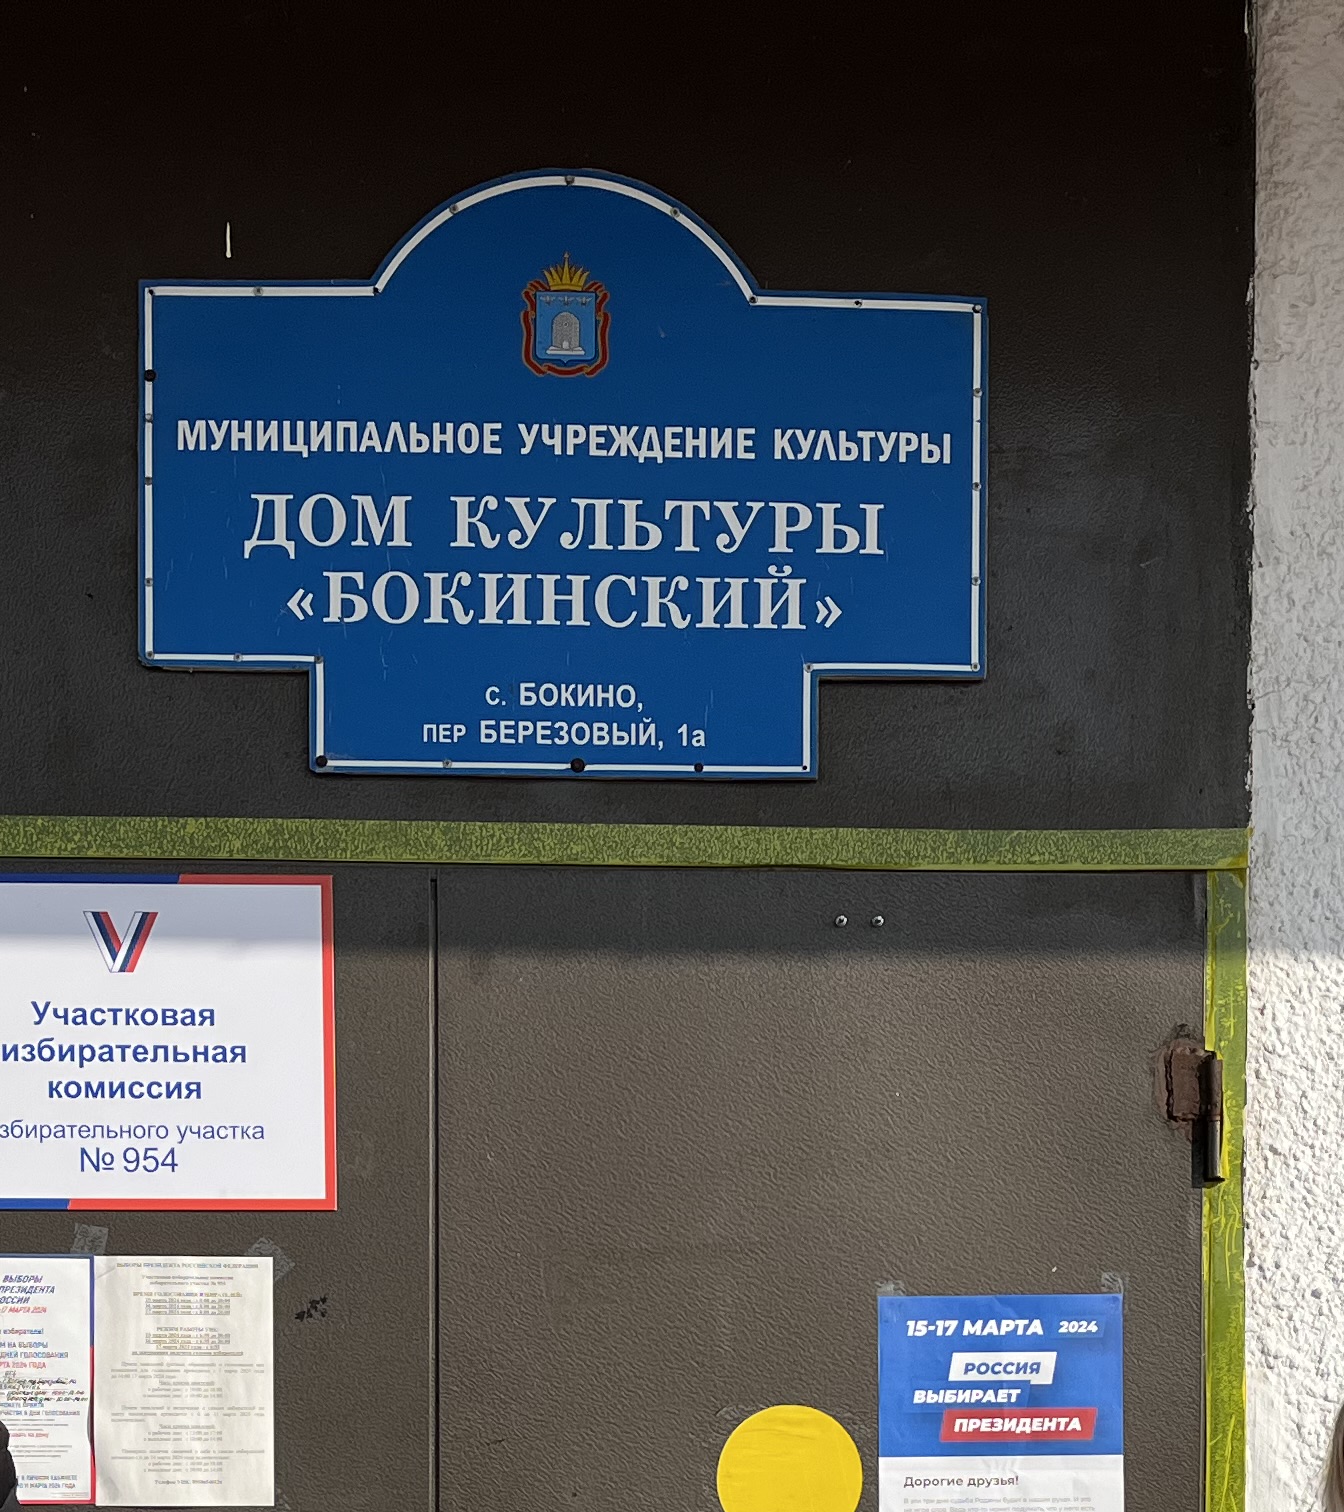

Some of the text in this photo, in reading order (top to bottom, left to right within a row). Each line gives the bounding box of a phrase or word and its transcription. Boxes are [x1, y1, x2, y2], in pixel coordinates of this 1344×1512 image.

[177, 419, 952, 466] МУНИЦИПАЛЬНОЕ УЧРЕЖДЕНИЕ КУЛЬТУРЫ
[244, 494, 884, 559] ДОМ КУЛЬТУРЫ
[288, 566, 842, 630] «БОКИНСКИЙ»
[519, 682, 643, 713] БОКИНО,
[479, 717, 663, 751] БЕРЕЗОВЫЙ,
[677, 727, 706, 748] 1а
[31, 1001, 215, 1027] Участковая
[1, 1039, 246, 1068] избирательная
[47, 1078, 202, 1099] комиссия
[176, 1123, 265, 1143] участка
[80, 1147, 179, 1173] № 954
[2, 1275, 43, 1283] ВЫБОРЫ
[906, 1319, 1099, 1336] 15-17 МАРТА 2024
[963, 1362, 1042, 1375] РОССИЯ
[913, 1389, 1021, 1404] ВЫБИРАЕТ
[954, 1418, 1082, 1435] ПРЕЗИДЕНТА
[903, 1476, 1019, 1488] Дорогие друзья!
